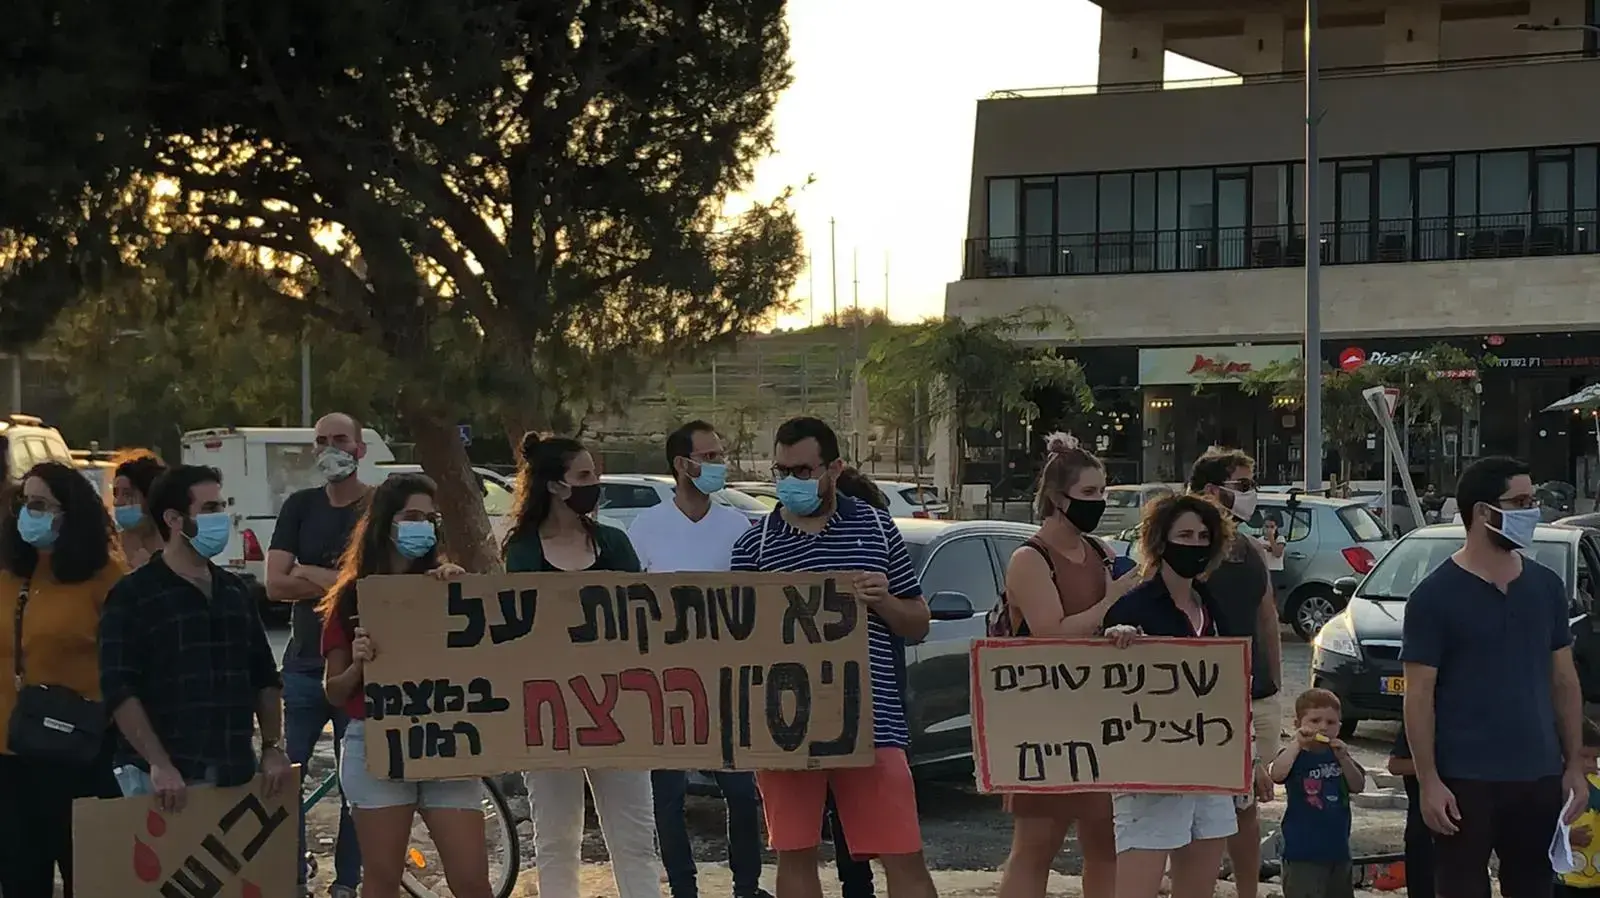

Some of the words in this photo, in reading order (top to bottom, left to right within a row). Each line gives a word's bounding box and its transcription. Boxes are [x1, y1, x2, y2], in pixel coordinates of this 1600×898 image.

[446, 583, 538, 649] על
[567, 582, 756, 654] שותקות
[781, 578, 859, 644] לא
[522, 667, 710, 752] הרצח
[990, 663, 1091, 692] טובים
[1102, 660, 1220, 698] שכנים
[719, 660, 861, 770] ניסיון
[1101, 702, 1235, 747] מצילים
[386, 717, 483, 779] רמון
[1014, 741, 1100, 783] חיים
